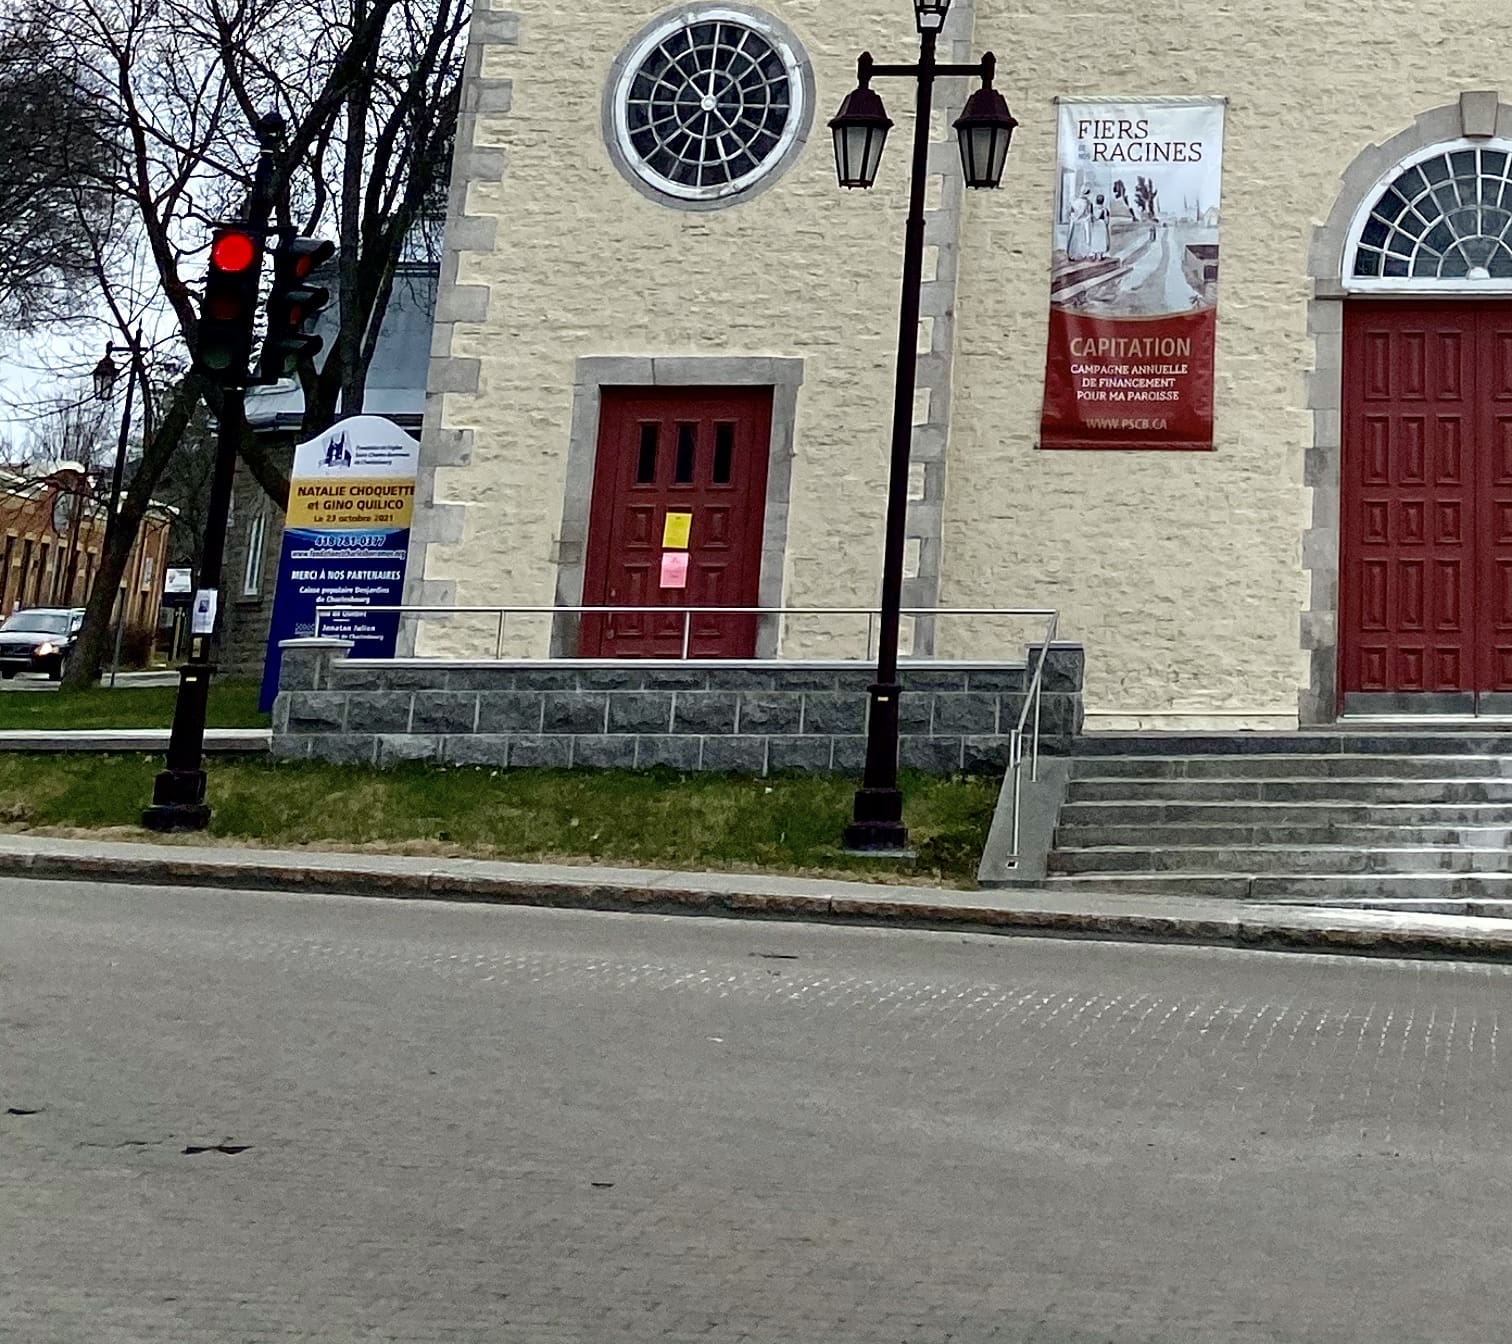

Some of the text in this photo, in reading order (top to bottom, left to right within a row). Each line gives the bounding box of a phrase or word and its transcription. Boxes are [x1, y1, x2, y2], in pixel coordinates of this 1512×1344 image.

[1078, 120, 1148, 139] FIERS
[1092, 142, 1202, 162] RACINES
[1070, 337, 1190, 357] CAPITATION
[1071, 364, 1188, 374] CAMPAGNE ANNUELLE
[1082, 378, 1176, 388] DE FINANCEMENT
[1077, 391, 1179, 401] POUR MA PAROISSE
[1087, 418, 1167, 430] WWW.PSCB.CA
[298, 486, 346, 496] NATALIE
[307, 499, 404, 511] et GINO QUILICO
[291, 570, 317, 580] MERCI
[328, 570, 345, 580] NOS
[347, 570, 401, 580] PARTENAIRES
